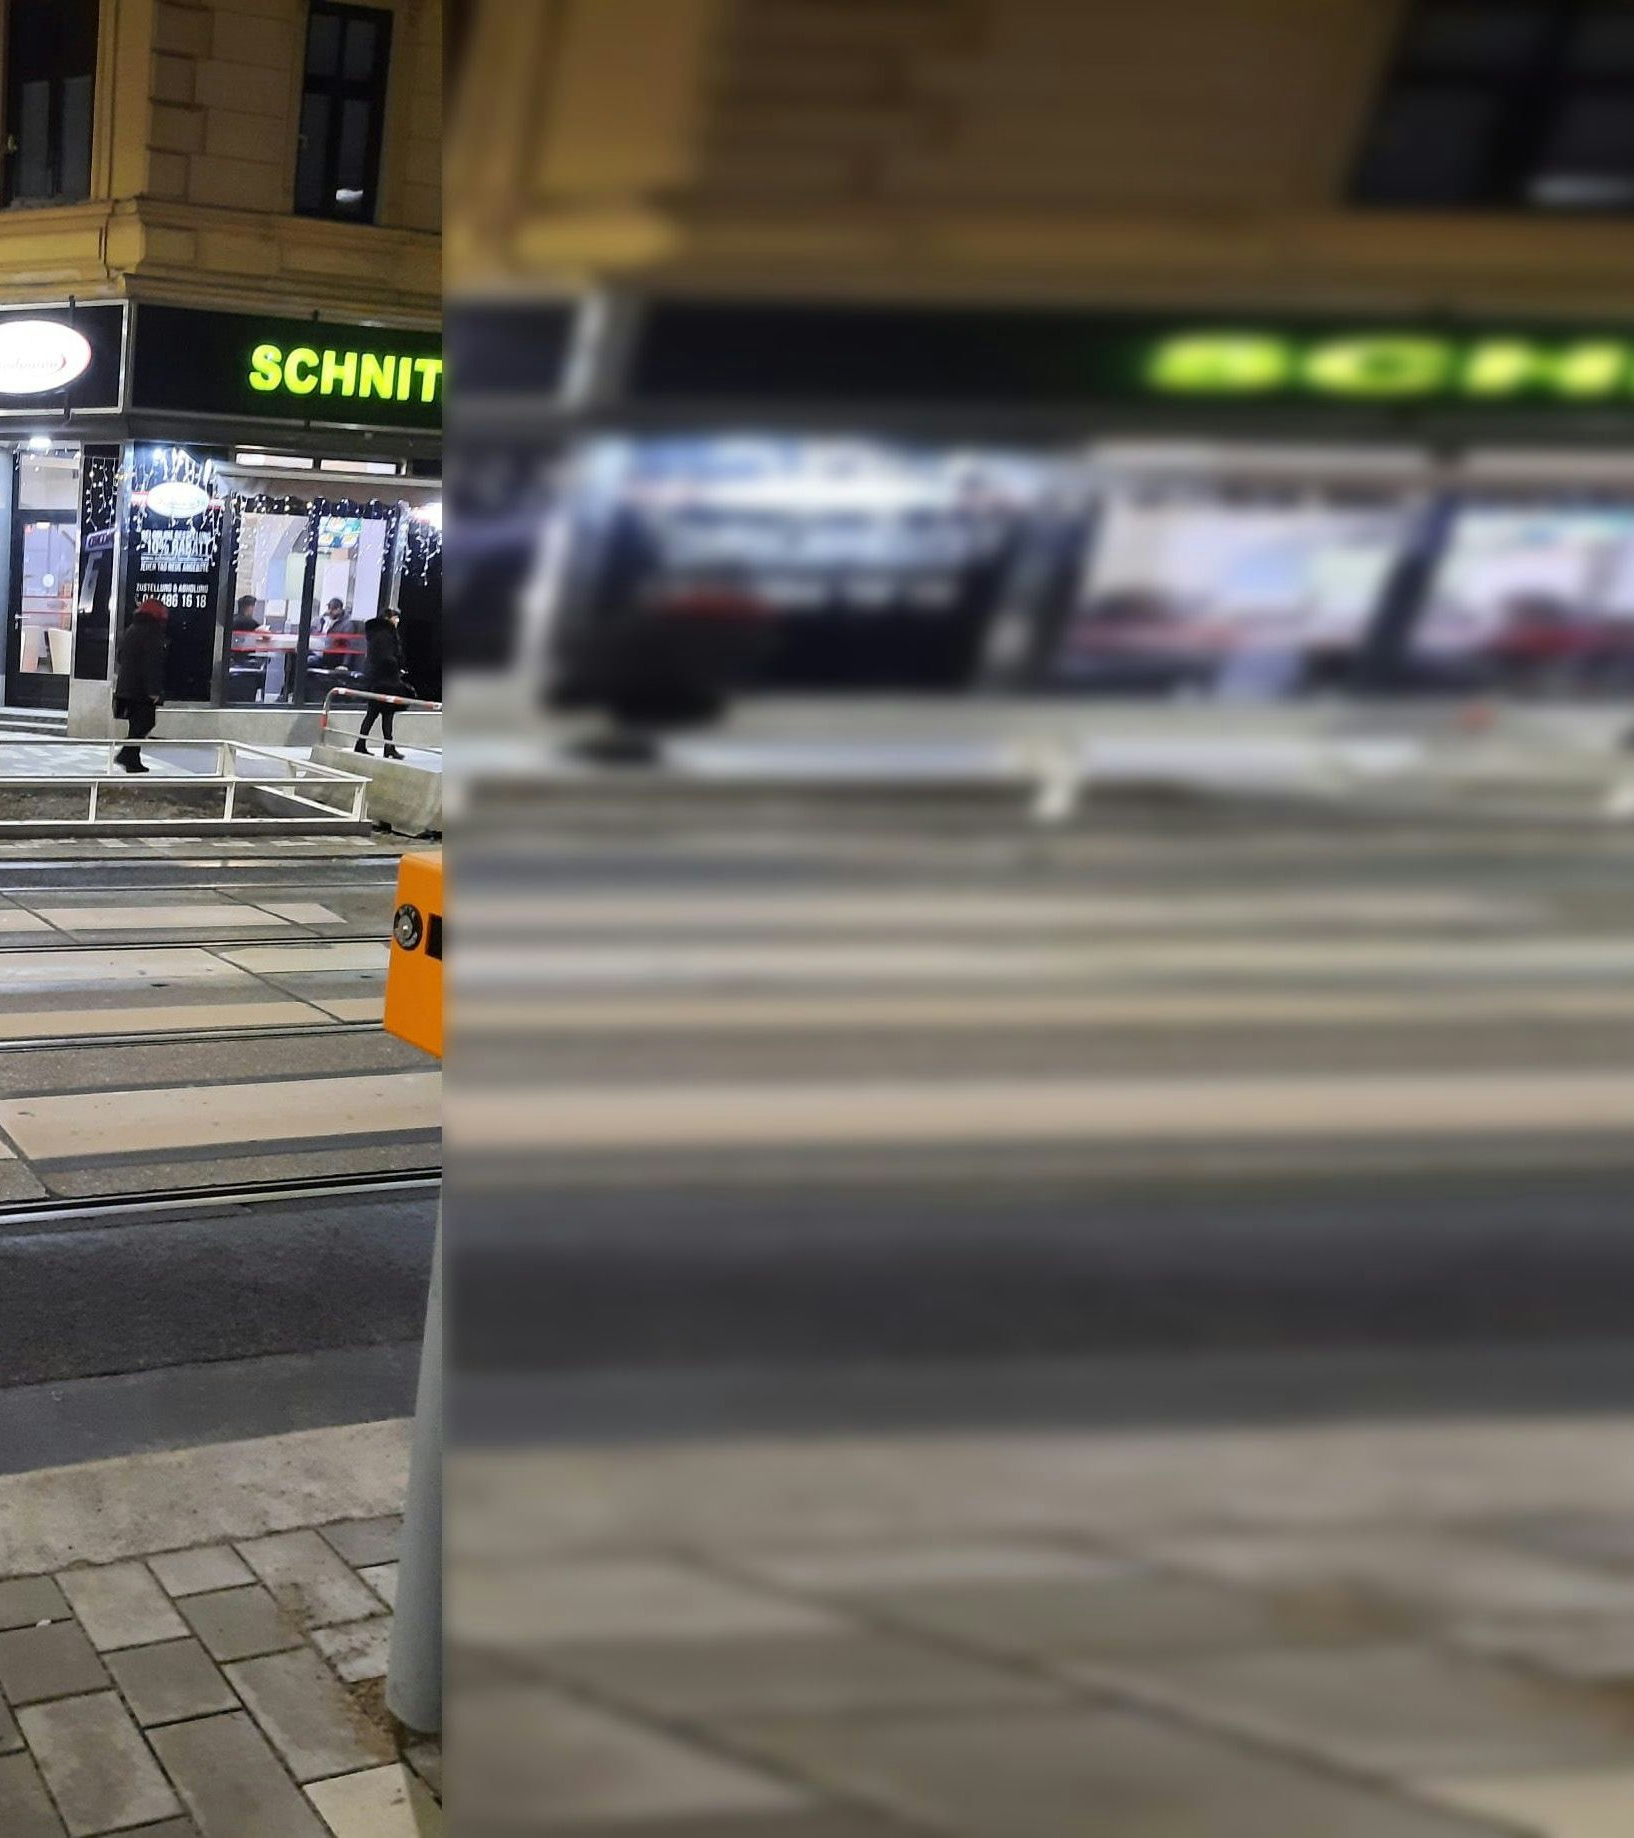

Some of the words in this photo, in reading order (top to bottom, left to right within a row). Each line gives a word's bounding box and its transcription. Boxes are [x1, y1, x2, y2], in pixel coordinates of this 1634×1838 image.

[249, 344, 442, 402] SCHNIT
[136, 583, 172, 593] ZUSTELLUNG
[181, 593, 193, 608] 16
[195, 594, 207, 609] 18
